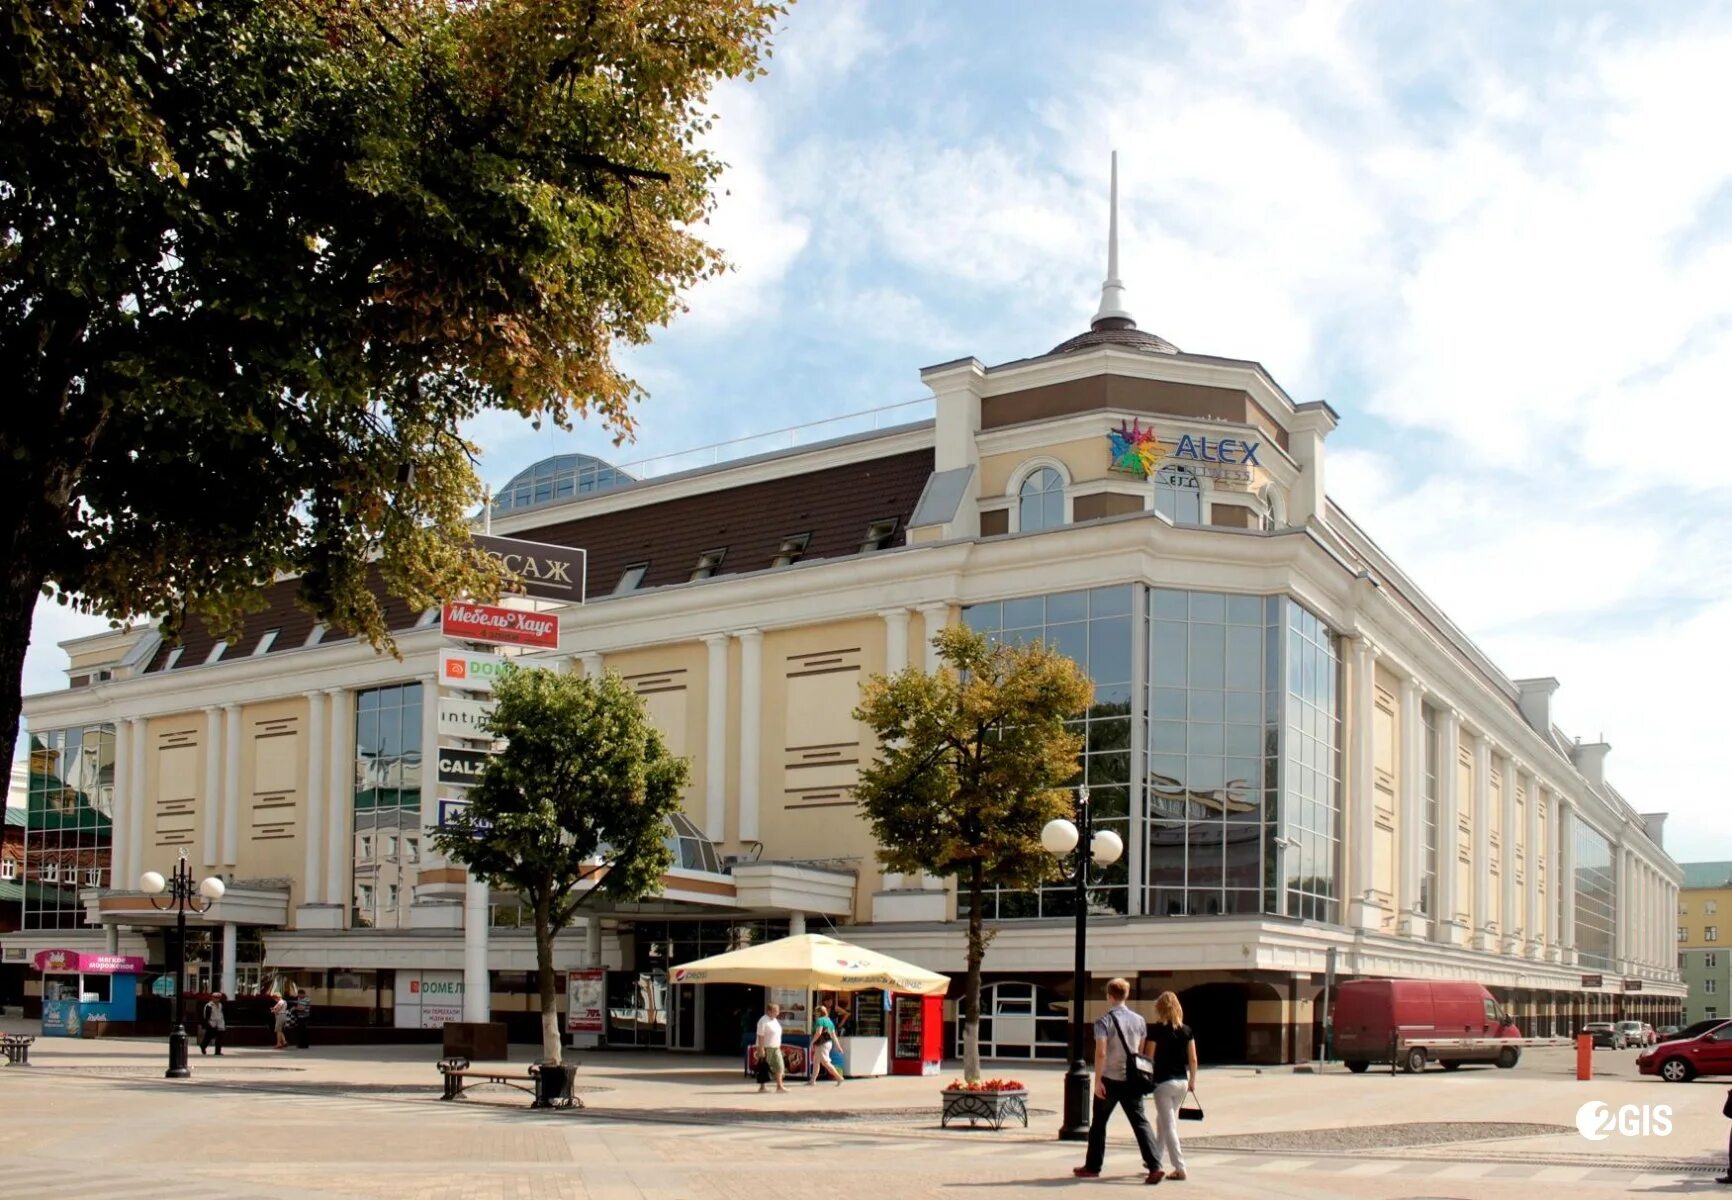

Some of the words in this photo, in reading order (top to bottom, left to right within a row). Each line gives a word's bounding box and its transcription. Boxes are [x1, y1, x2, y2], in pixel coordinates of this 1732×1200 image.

[1175, 434, 1260, 466] ALEX
[448, 604, 508, 628] Мебель
[515, 613, 553, 636] Хаус
